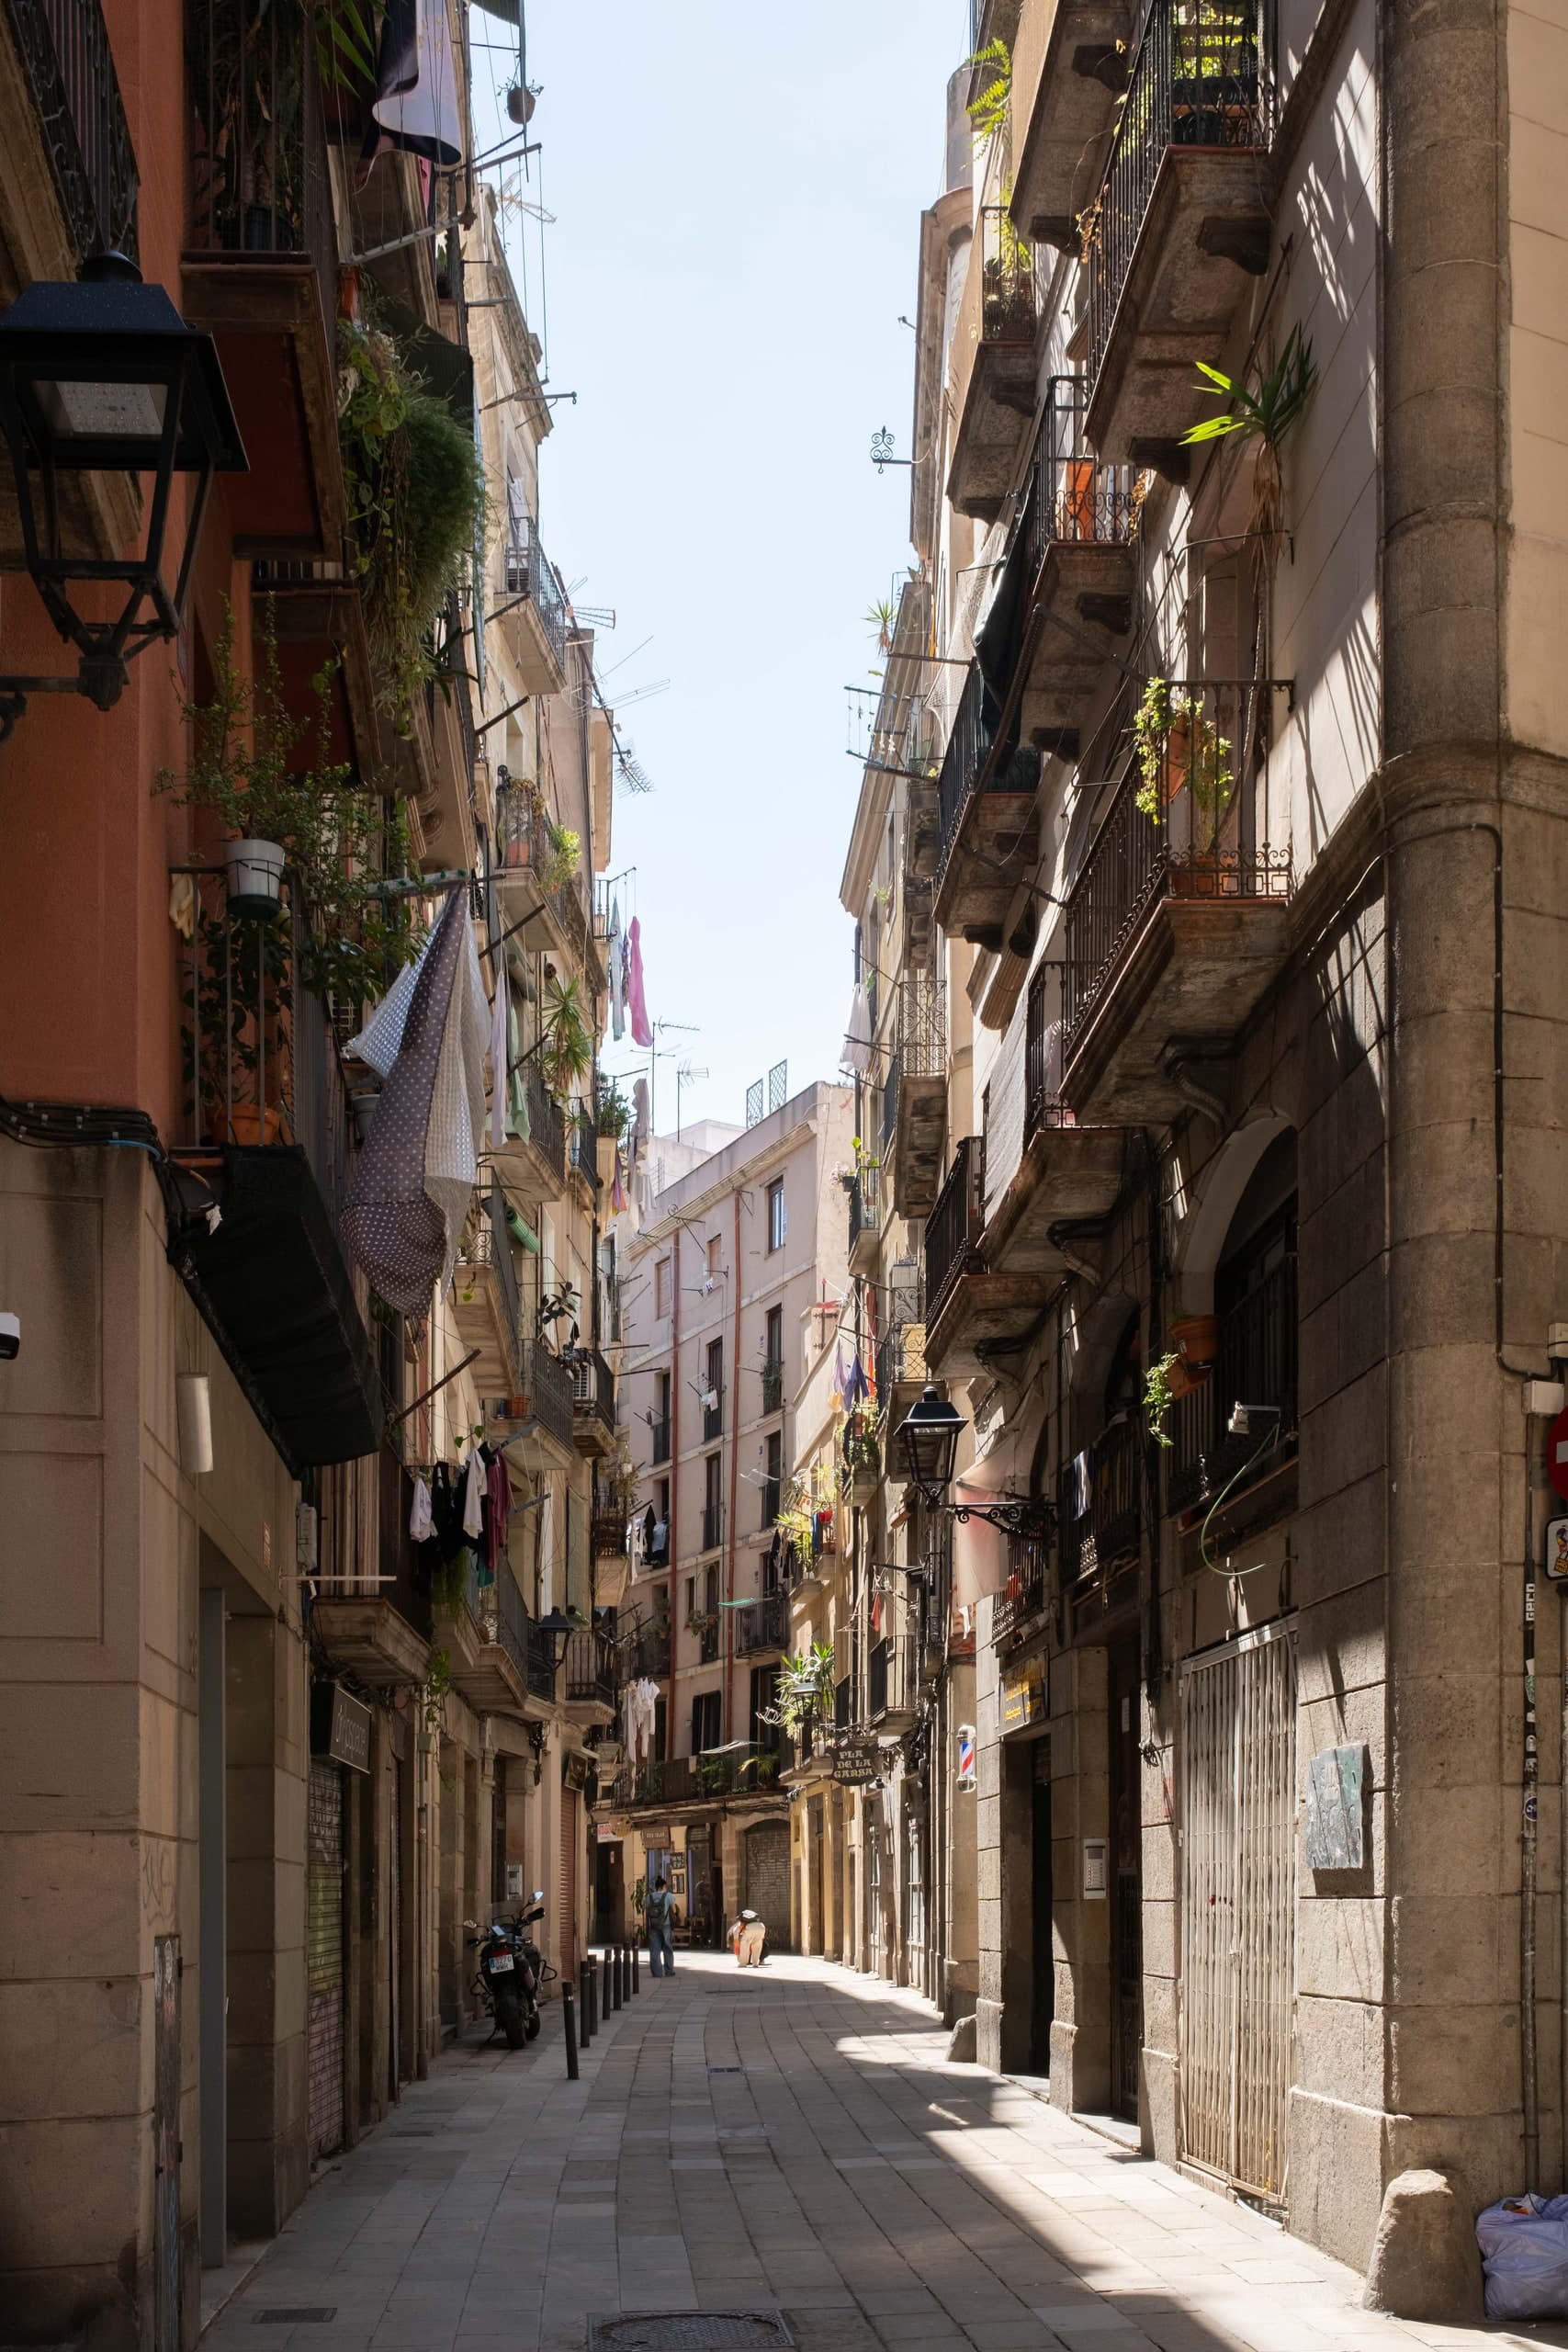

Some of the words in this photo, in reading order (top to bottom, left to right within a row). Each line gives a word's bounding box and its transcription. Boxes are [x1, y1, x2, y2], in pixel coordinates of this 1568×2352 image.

[839, 1749, 864, 1759] PLA
[837, 1760, 852, 1770] DE
[855, 1758, 872, 1768] LA
